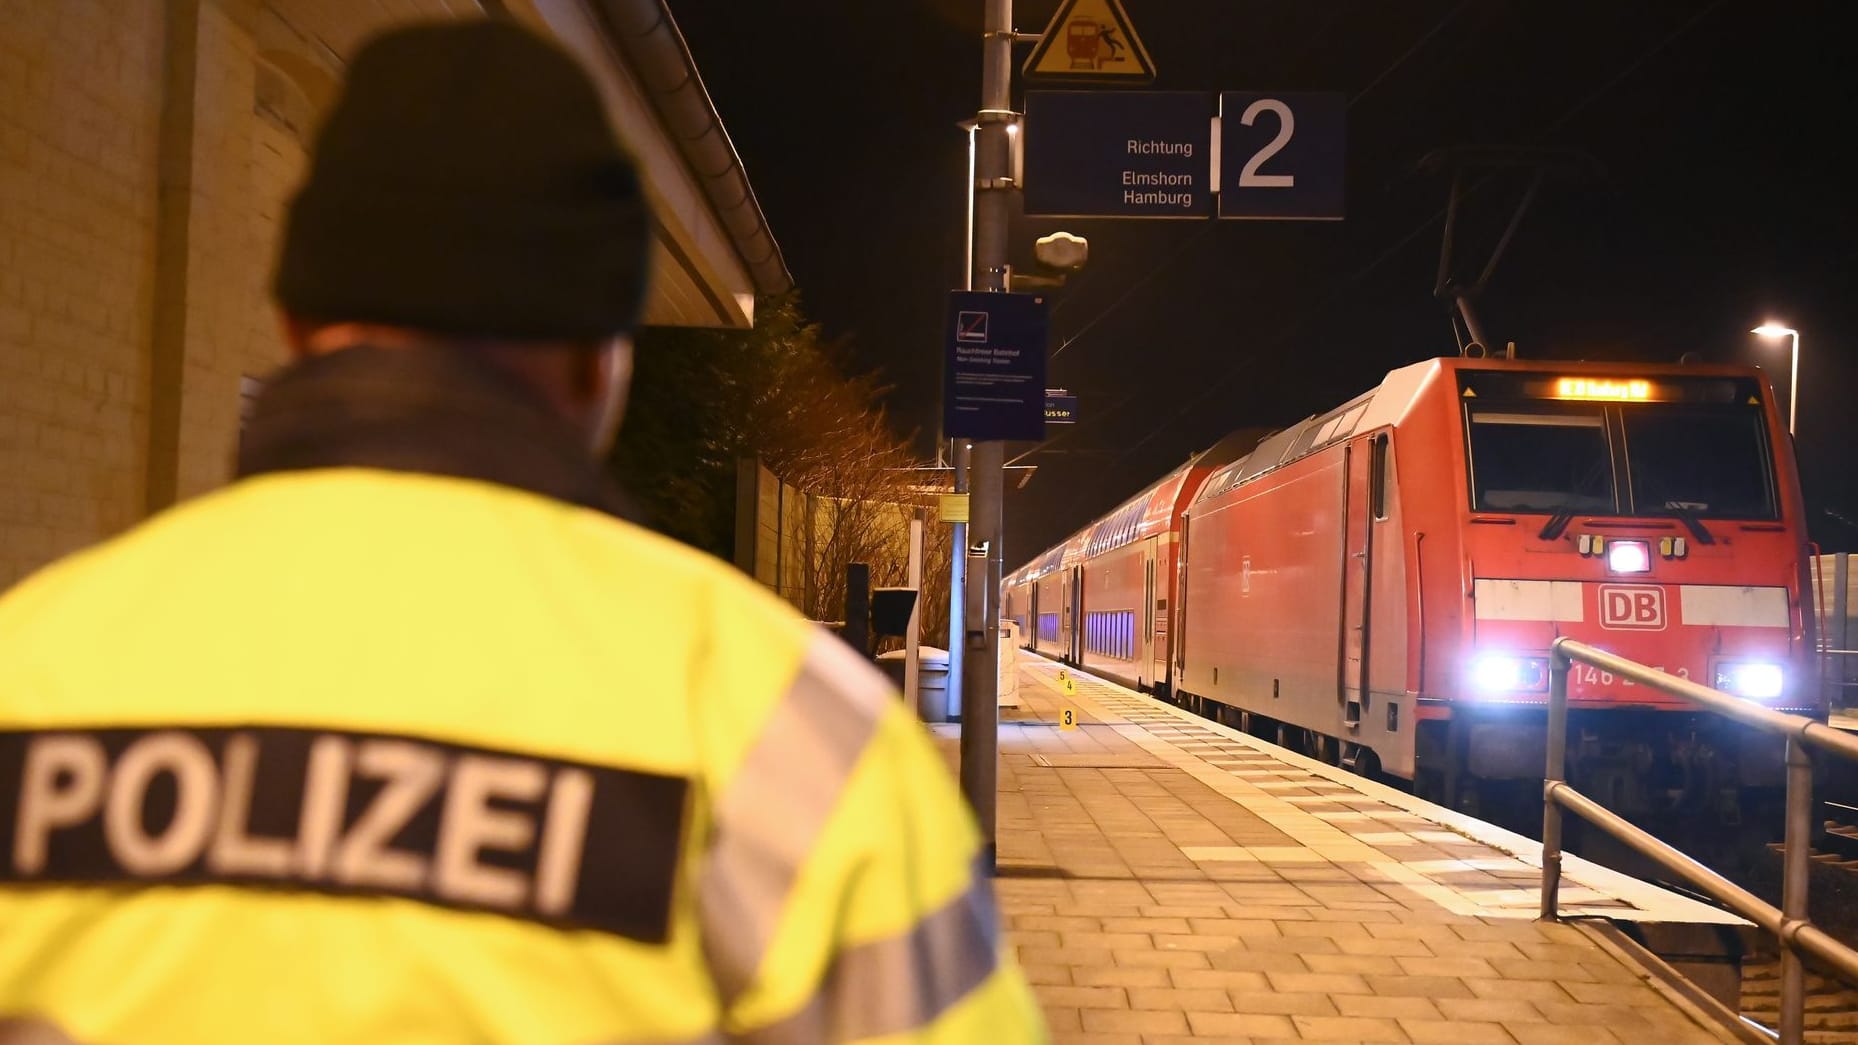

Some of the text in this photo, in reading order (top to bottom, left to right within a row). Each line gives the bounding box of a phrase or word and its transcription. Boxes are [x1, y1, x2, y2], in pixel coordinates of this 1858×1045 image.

[1127, 139, 1193, 158] Richtung
[1238, 98, 1295, 188] 2
[1122, 171, 1192, 186] Elmshorn
[1124, 190, 1192, 207] Hamburg
[1608, 592, 1658, 622] DB
[1060, 671, 1065, 681] 5
[1575, 664, 1614, 685] 146
[1067, 680, 1072, 691] 4
[1065, 710, 1072, 725] 3
[12, 731, 596, 915] POLIZEI
